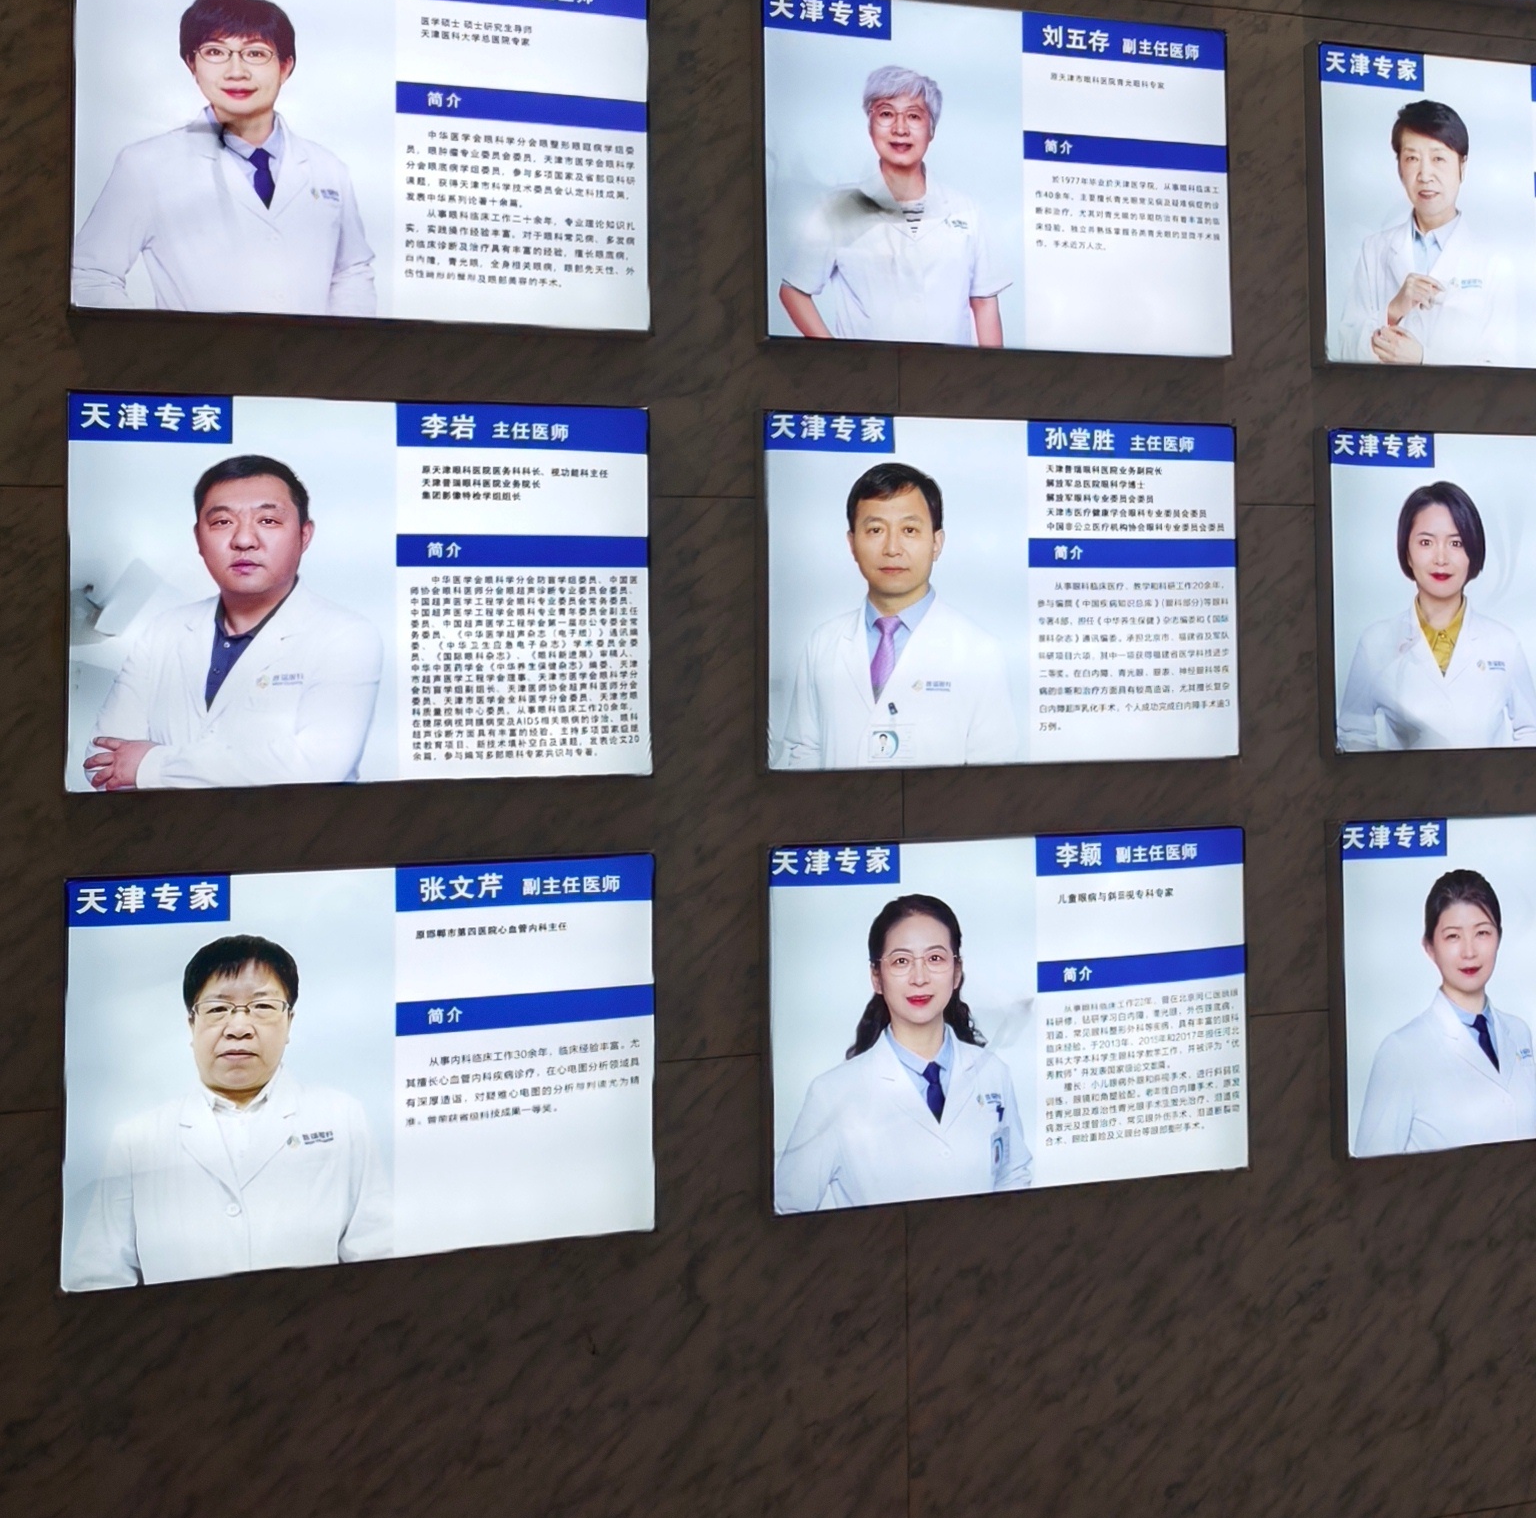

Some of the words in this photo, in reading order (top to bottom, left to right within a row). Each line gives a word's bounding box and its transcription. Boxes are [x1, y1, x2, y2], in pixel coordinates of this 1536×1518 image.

[420, 15, 460, 29] 医学硕士
[462, 19, 533, 34] 硕士研究生导师
[420, 28, 530, 47] 天津医科大学总医院专家
[1041, 23, 1110, 53] 刘五存
[1121, 37, 1200, 61] 副主任医师
[1325, 51, 1418, 82] 天津专家
[426, 90, 462, 109] 简介
[1043, 138, 1073, 155] 简介
[80, 402, 222, 432] 天津专家
[420, 412, 477, 440] 李岩
[491, 420, 569, 442] 主任医师
[771, 415, 886, 443] 天津专家
[1044, 426, 1115, 451] 孙堂胜
[1129, 434, 1195, 453] 主任医师
[1334, 433, 1428, 459] 天津专家
[426, 541, 462, 559] 简介
[1053, 544, 1084, 560] 简介
[1343, 822, 1440, 849] 天津专家
[773, 846, 891, 876] 天津专家
[1055, 841, 1103, 869] 李颖
[1115, 842, 1198, 864] 副主任医师
[76, 881, 219, 915] 天津专家
[419, 872, 504, 903] 张文芹
[521, 874, 621, 896] 副主任医师
[1062, 965, 1093, 983] 简介
[426, 1005, 463, 1025] 简介
